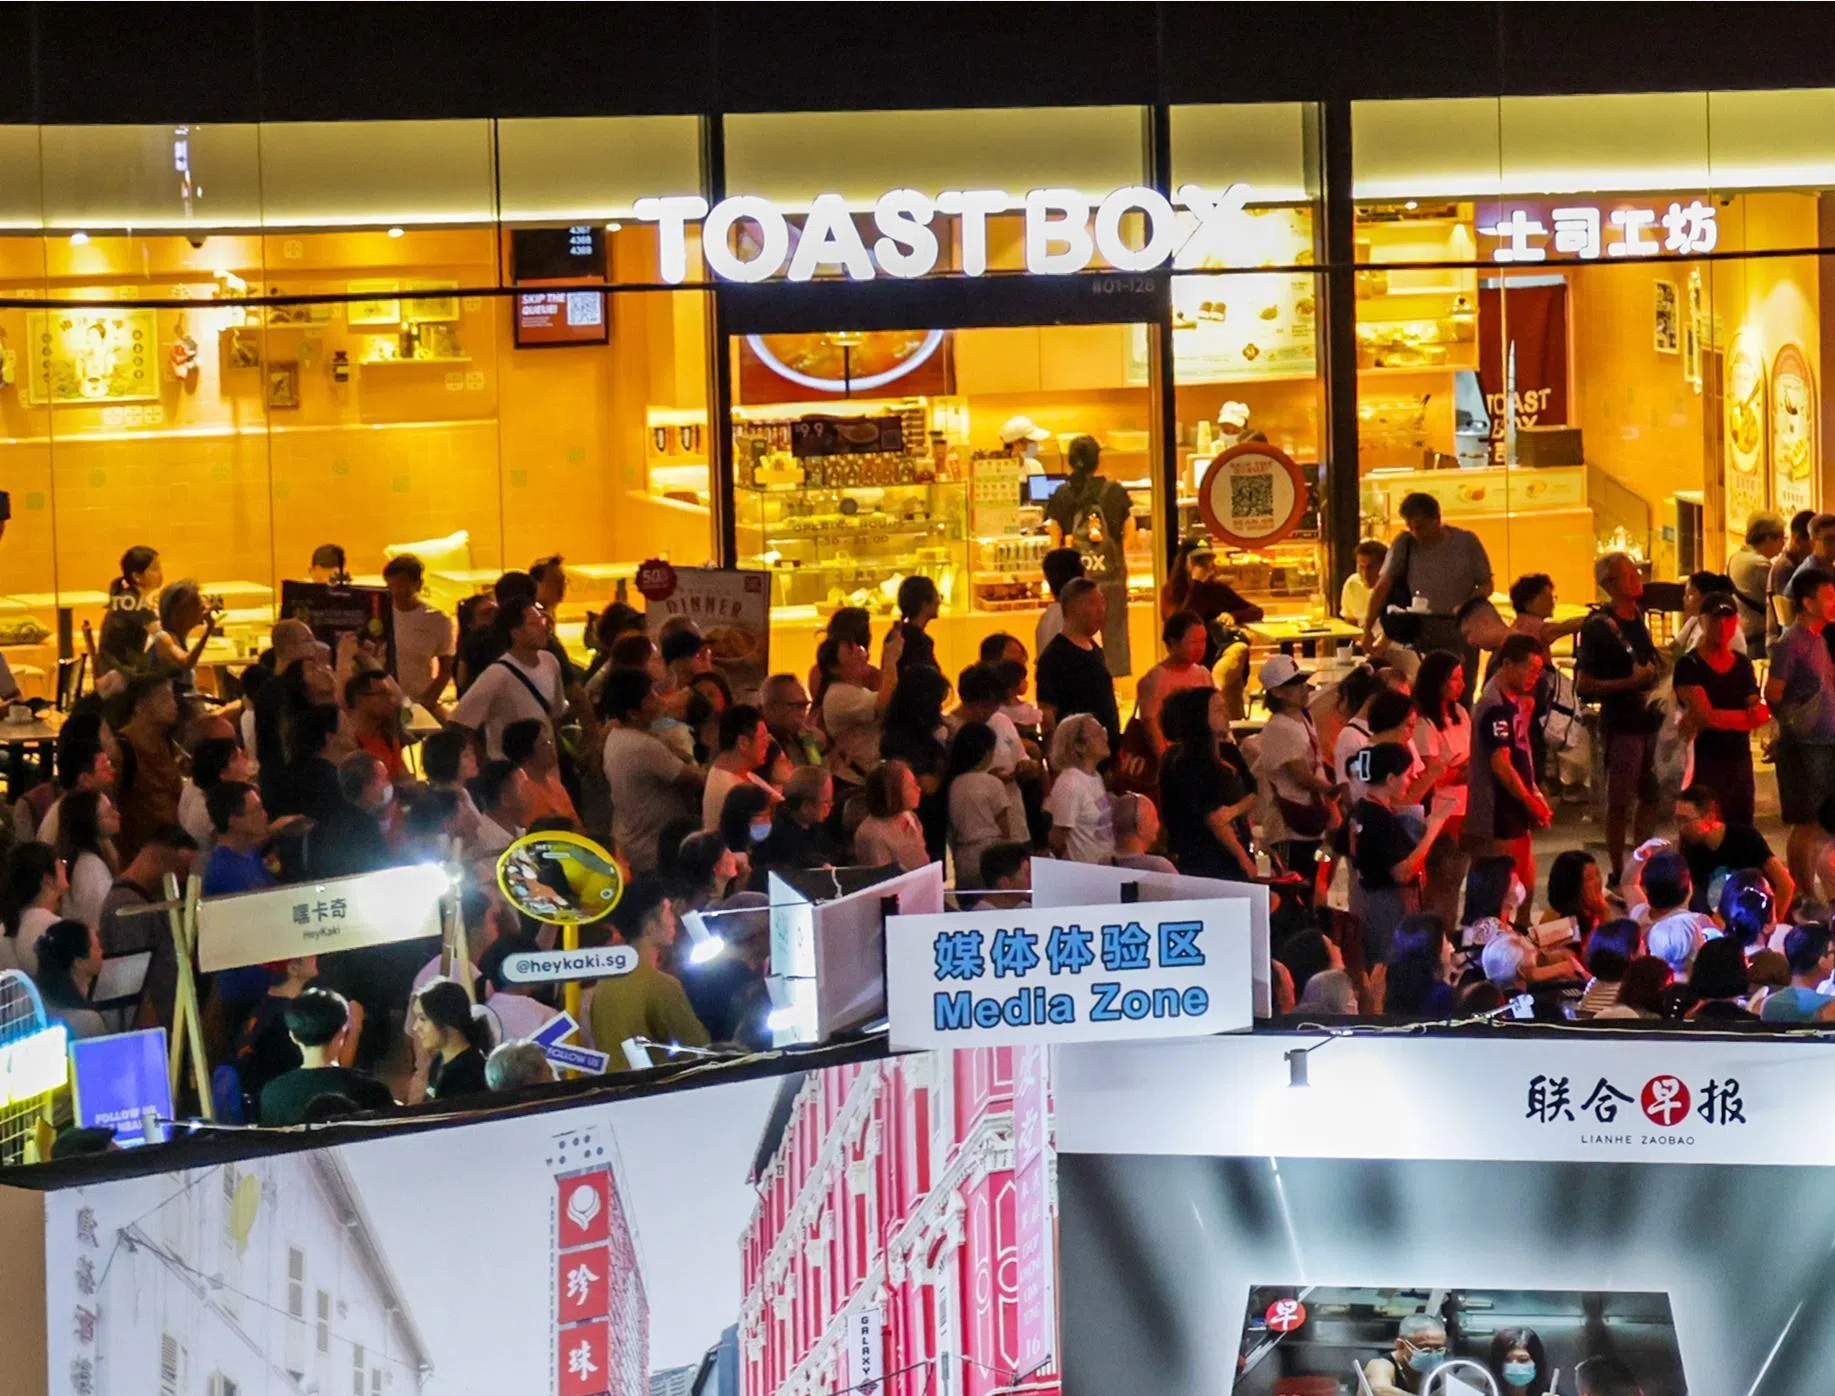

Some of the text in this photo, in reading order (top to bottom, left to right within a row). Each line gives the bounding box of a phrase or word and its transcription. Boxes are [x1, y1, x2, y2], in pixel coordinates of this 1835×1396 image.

[632, 183, 1251, 285] TOAST BOX
[1493, 199, 1718, 262] 土司工坊
[292, 898, 347, 925] 嘿卡奇
[303, 927, 341, 940] HeyKaki
[516, 953, 627, 974] @heykaki.sg
[933, 919, 1206, 981] 媒体体验区
[933, 982, 1210, 1031] Media Zone
[1524, 1072, 1748, 1128] 联合早报
[1579, 1133, 1696, 1147] LIANHE ZAOBAO
[1271, 1300, 1302, 1329] 早
[859, 1315, 872, 1378] GALAXY
